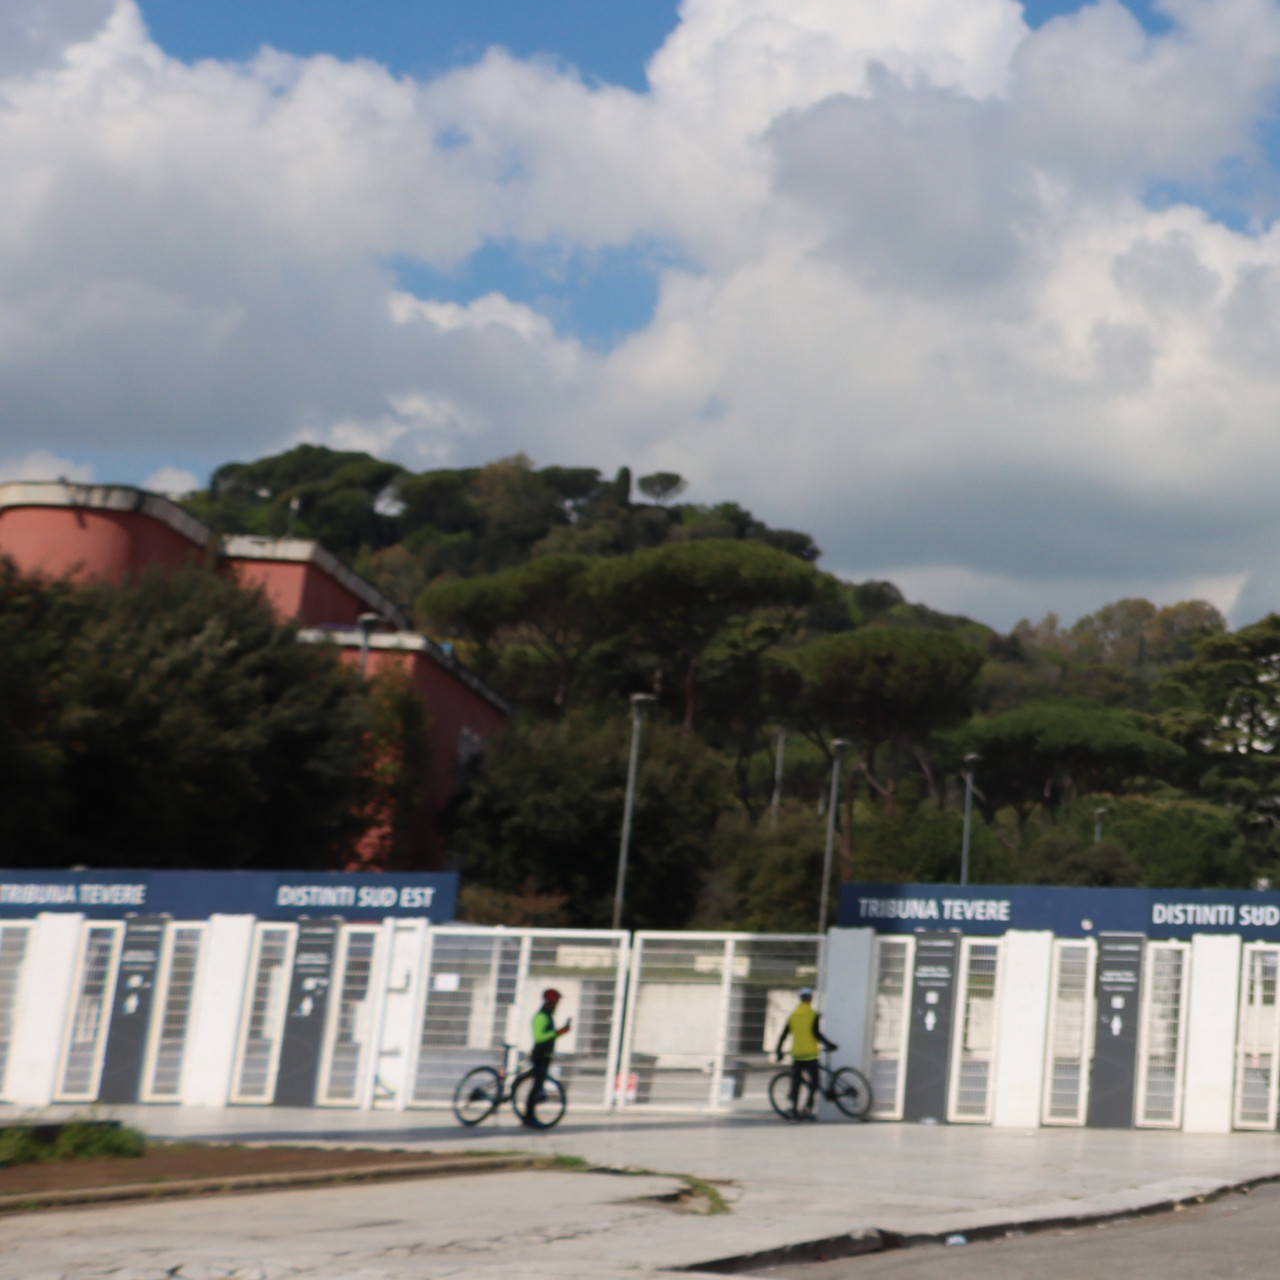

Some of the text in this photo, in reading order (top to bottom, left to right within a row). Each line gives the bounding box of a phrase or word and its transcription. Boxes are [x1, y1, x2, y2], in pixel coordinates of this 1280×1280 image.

[0, 884, 435, 908] TRIBUNA TEVERE DISTINTI SUD EST
[858, 898, 939, 920] TRIBUNA
[942, 900, 1011, 921] TEVERE
[1152, 903, 1235, 925] DISTINTI
[1239, 904, 1280, 926] SUD
